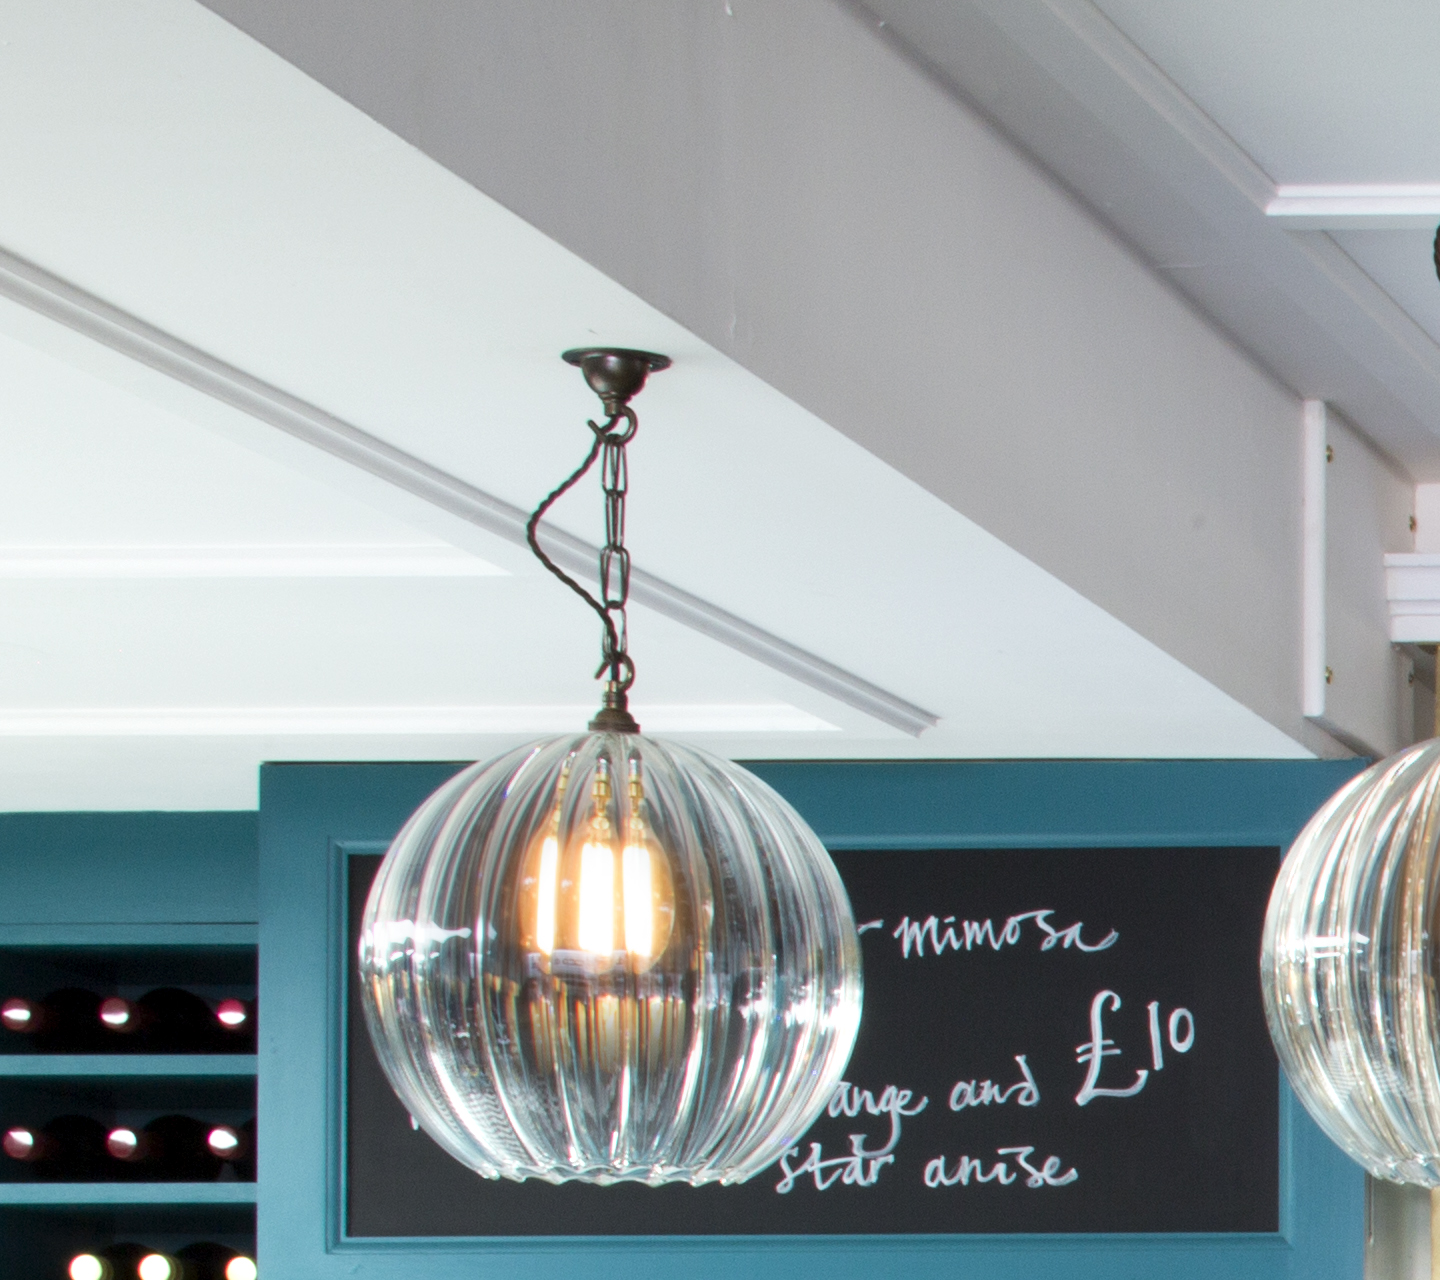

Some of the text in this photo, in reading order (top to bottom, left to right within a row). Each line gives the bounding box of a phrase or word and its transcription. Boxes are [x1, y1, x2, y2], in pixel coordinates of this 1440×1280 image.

[893, 909, 1120, 960] mimosa
[1074, 988, 1195, 1106] £10
[827, 1054, 1040, 1158] ange and
[776, 1142, 1079, 1195] star anise
